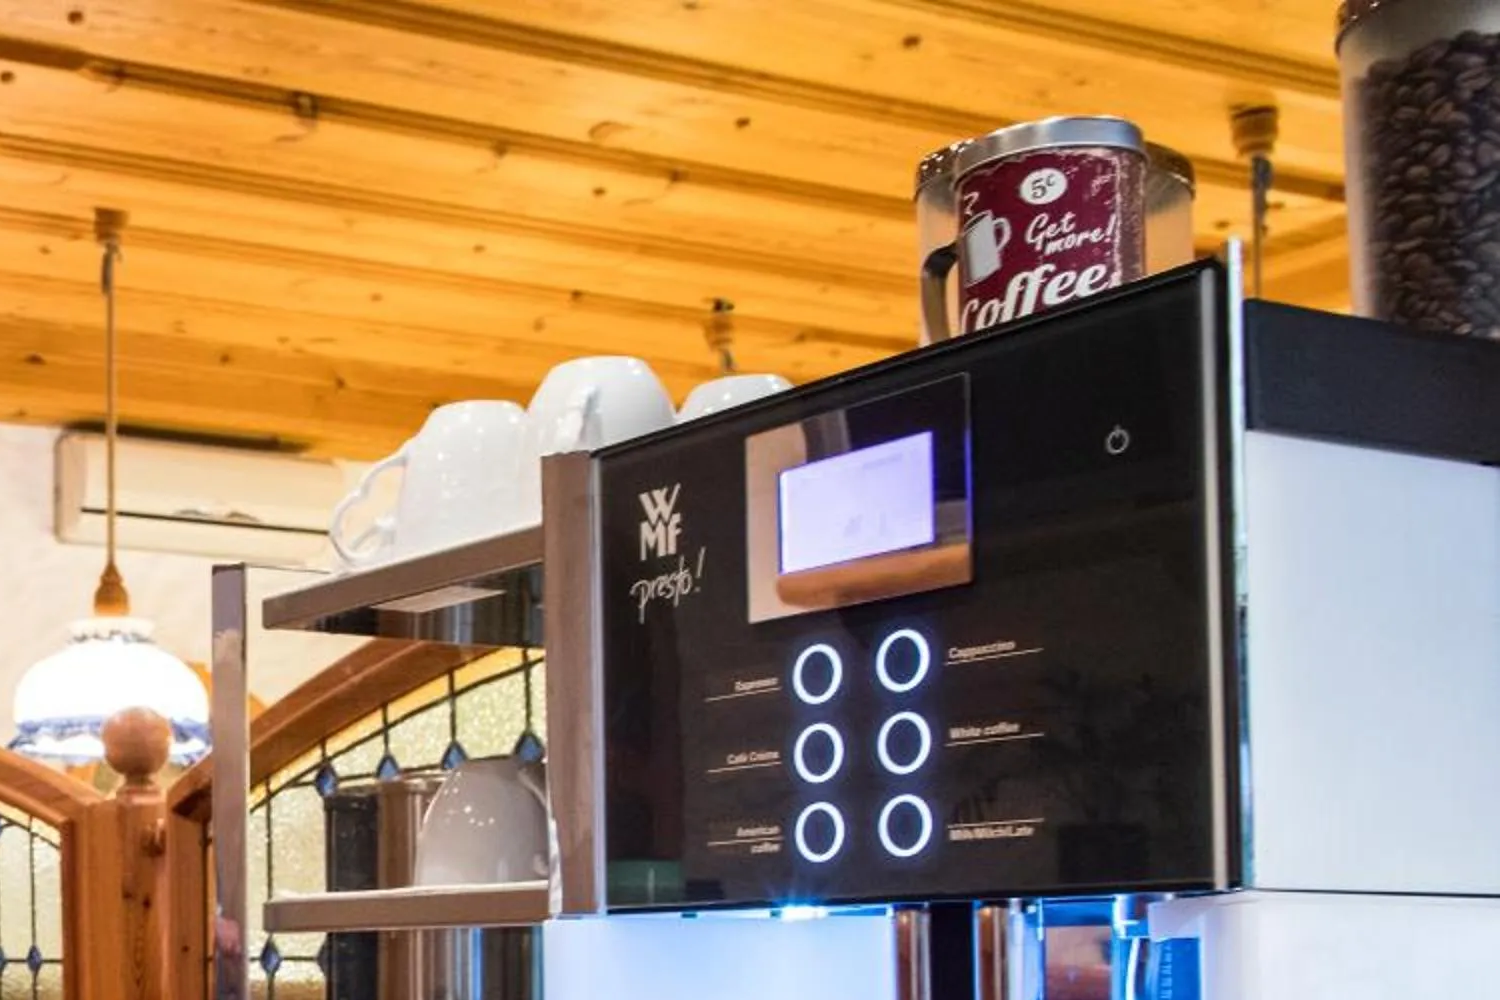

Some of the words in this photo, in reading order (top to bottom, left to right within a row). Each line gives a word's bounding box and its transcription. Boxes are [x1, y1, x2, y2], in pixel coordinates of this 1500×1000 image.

[1025, 211, 1076, 251] Get
[1044, 213, 1117, 256] more!
[638, 481, 682, 562] WMF
